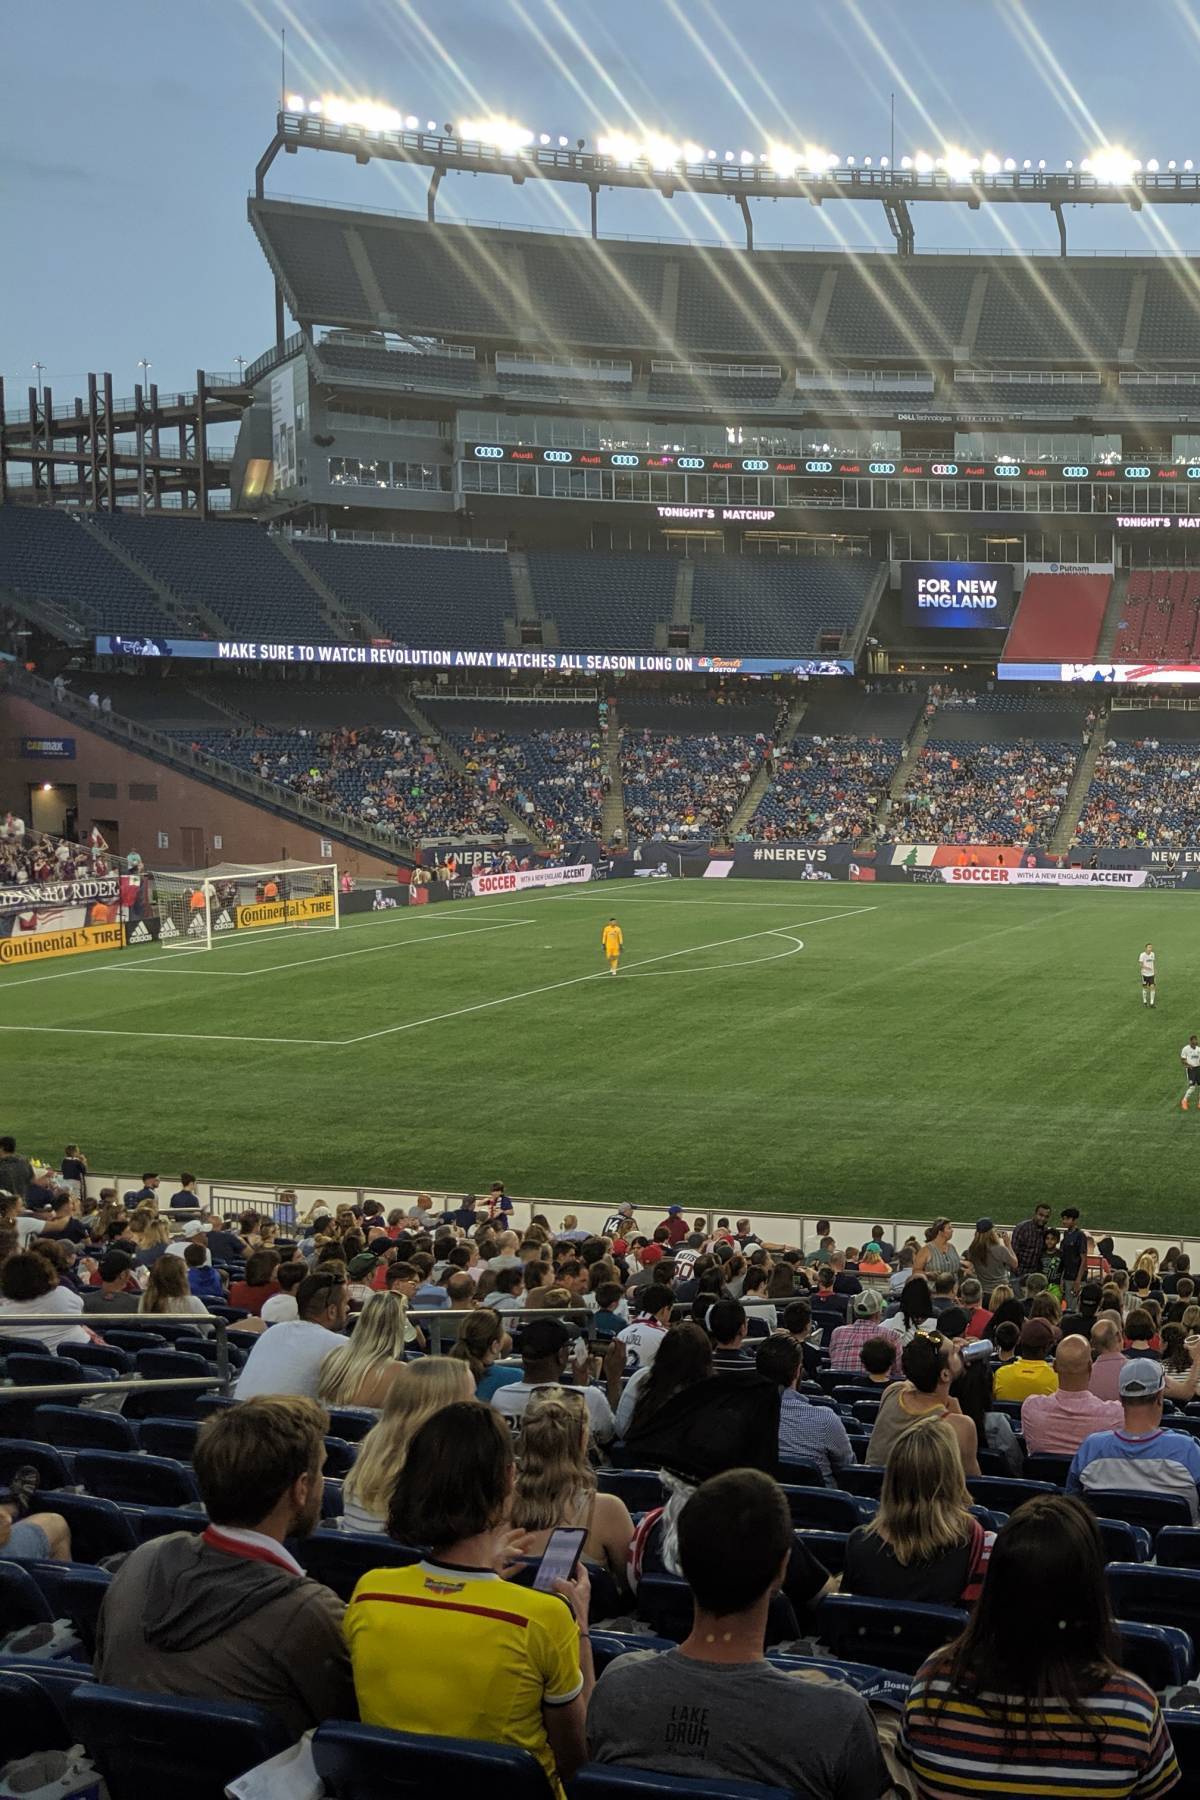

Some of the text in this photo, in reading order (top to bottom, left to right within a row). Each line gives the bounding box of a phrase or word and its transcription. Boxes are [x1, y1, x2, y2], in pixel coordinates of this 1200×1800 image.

[512, 450, 533, 459] Audi
[580, 455, 600, 464] Audi
[712, 461, 732, 469] Audi
[776, 464, 796, 472] Audi
[840, 464, 860, 473] Audi
[903, 466, 922, 474] Audi
[965, 467, 984, 475] Audi
[1028, 468, 1046, 476] Audi
[1096, 470, 1115, 478] Audi
[1158, 470, 1177, 478] Audi
[658, 507, 775, 521] TONIGHT'S MATCHUP
[1116, 518, 1170, 528] TONIGHT'S
[1059, 564, 1089, 573] Putnam
[918, 579, 998, 595] FOR NEW
[918, 594, 998, 610] ENGLAND
[219, 645, 692, 672] MAKE SURE TO WATCH REVOLUTION AWAY MATCHES ALL SEASON LONG ON
[712, 658, 742, 668] Sports
[754, 848, 827, 862] #NEREVS
[1151, 852, 1180, 862] NEW
[479, 874, 516, 892] SOCCER
[520, 876, 530, 884] WITH
[545, 872, 562, 880] ENGLAND
[562, 868, 585, 880] ACCENT
[952, 868, 1008, 882] SOCCER
[1090, 872, 1133, 882] ACCENT
[73, 881, 120, 899] RIDER
[310, 901, 332, 914] TIRE
[214, 922, 234, 930] adidas
[130, 934, 152, 944] adidas
[158, 930, 180, 940] adidas
[0, 929, 122, 963] Continental TIRE
[605, 1218, 619, 1232] 14
[884, 1680, 909, 1691] Boats
[672, 1705, 710, 1726] LAKE
[665, 1722, 710, 1748] DRUM
